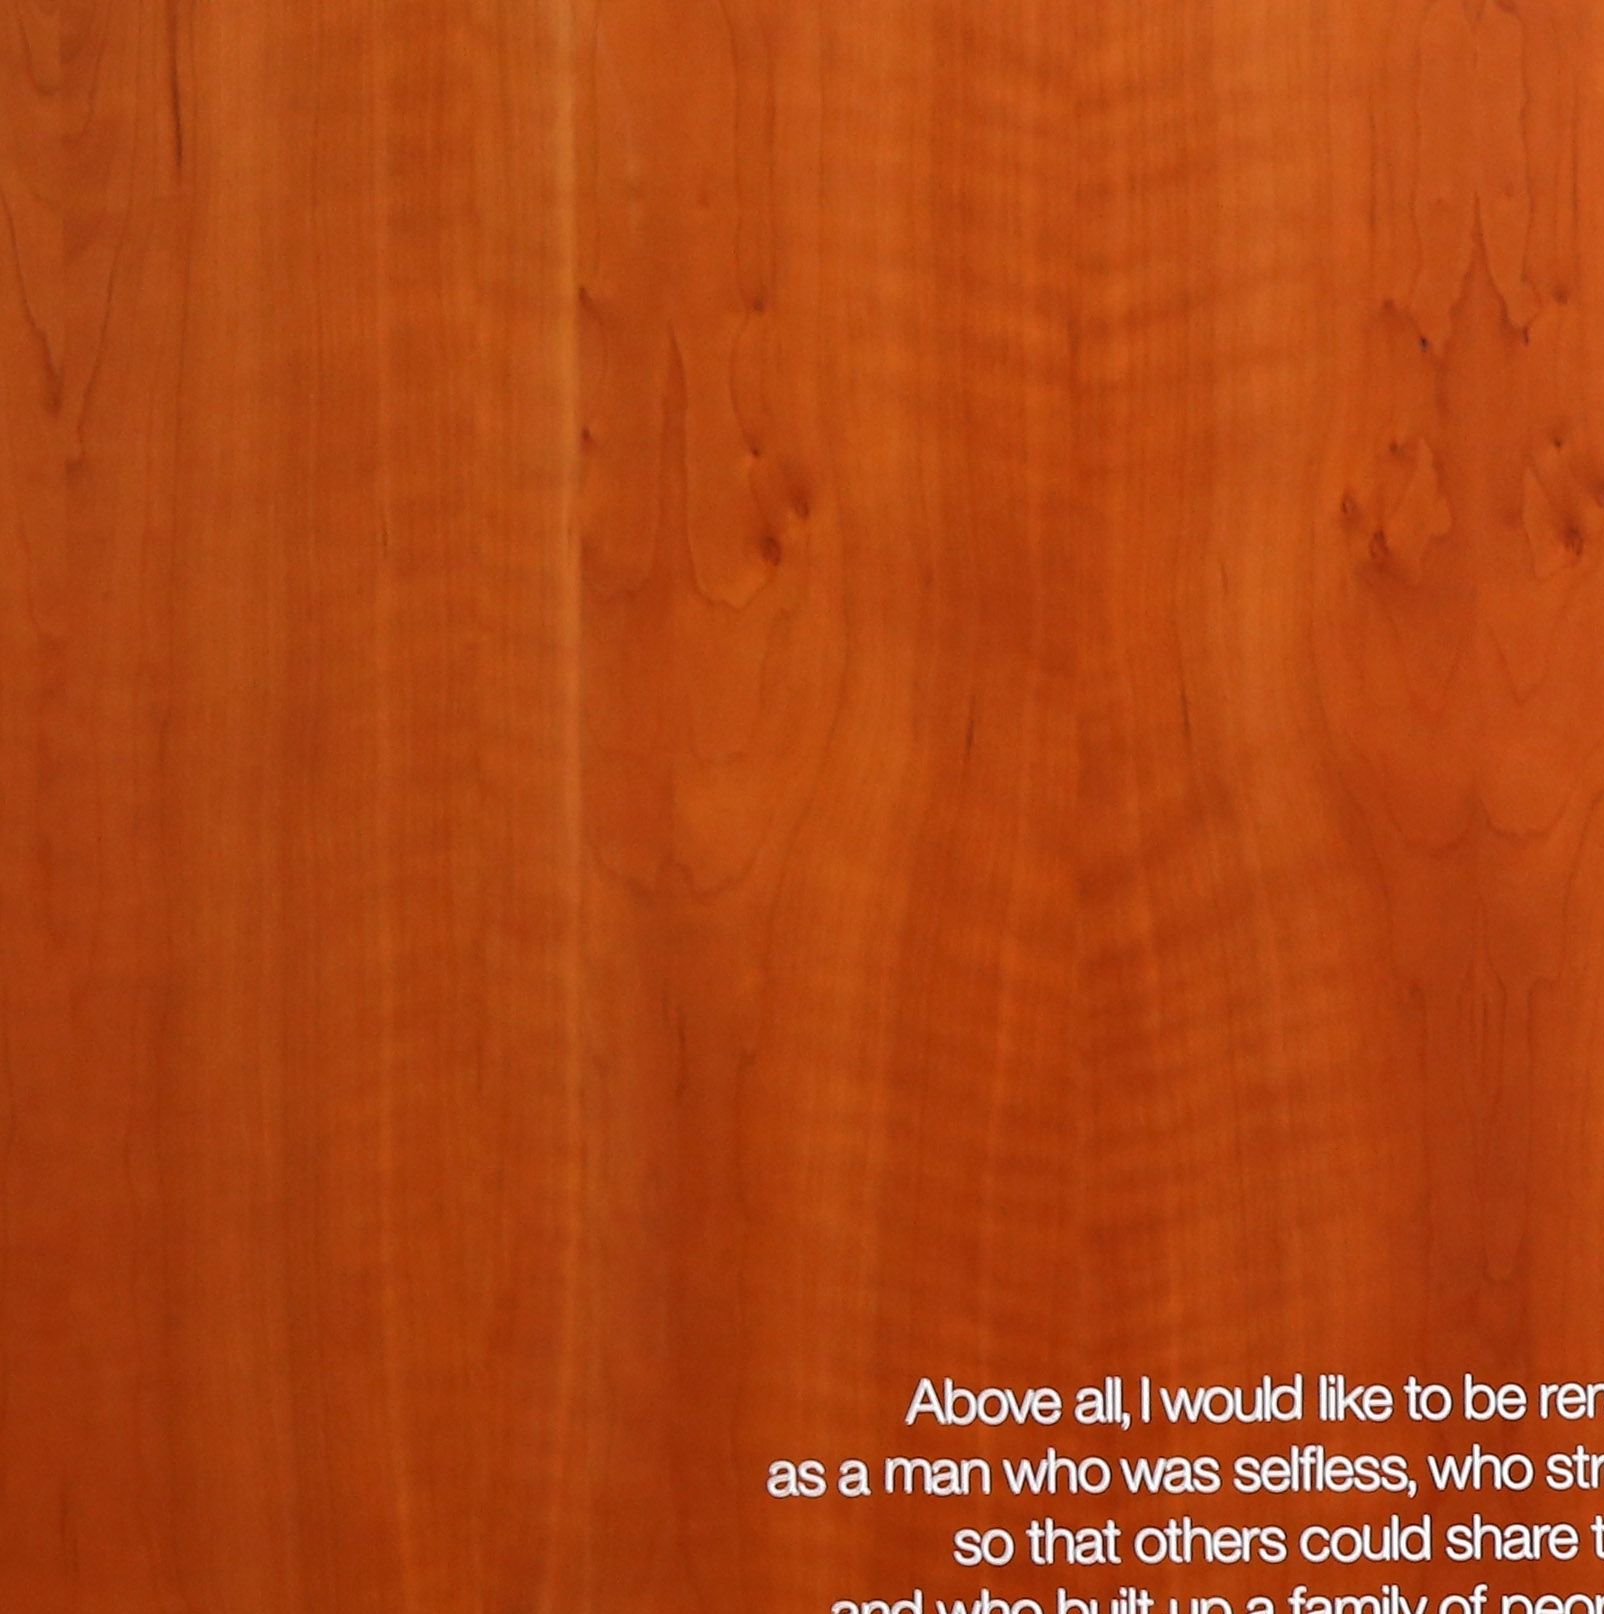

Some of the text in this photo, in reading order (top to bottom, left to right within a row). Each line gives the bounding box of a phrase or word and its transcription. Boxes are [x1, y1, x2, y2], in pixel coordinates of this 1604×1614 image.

[906, 1379, 1062, 1426] Above
[1076, 1378, 1131, 1431] all,
[1142, 1377, 1151, 1423] I
[1161, 1375, 1303, 1423] would
[1321, 1376, 1394, 1422] like
[1405, 1378, 1452, 1421] to
[1466, 1375, 1527, 1421] be
[768, 1462, 827, 1498] as
[840, 1461, 872, 1497] a
[886, 1459, 991, 1496] man
[1004, 1449, 1111, 1495] who
[1121, 1458, 1221, 1494] was
[1235, 1446, 1417, 1498] selfless,
[1429, 1445, 1534, 1491] who
[955, 1530, 1015, 1566] so
[1027, 1519, 1122, 1565] that
[1136, 1518, 1287, 1564] others
[1301, 1516, 1432, 1563] could
[1447, 1515, 1579, 1561] share
